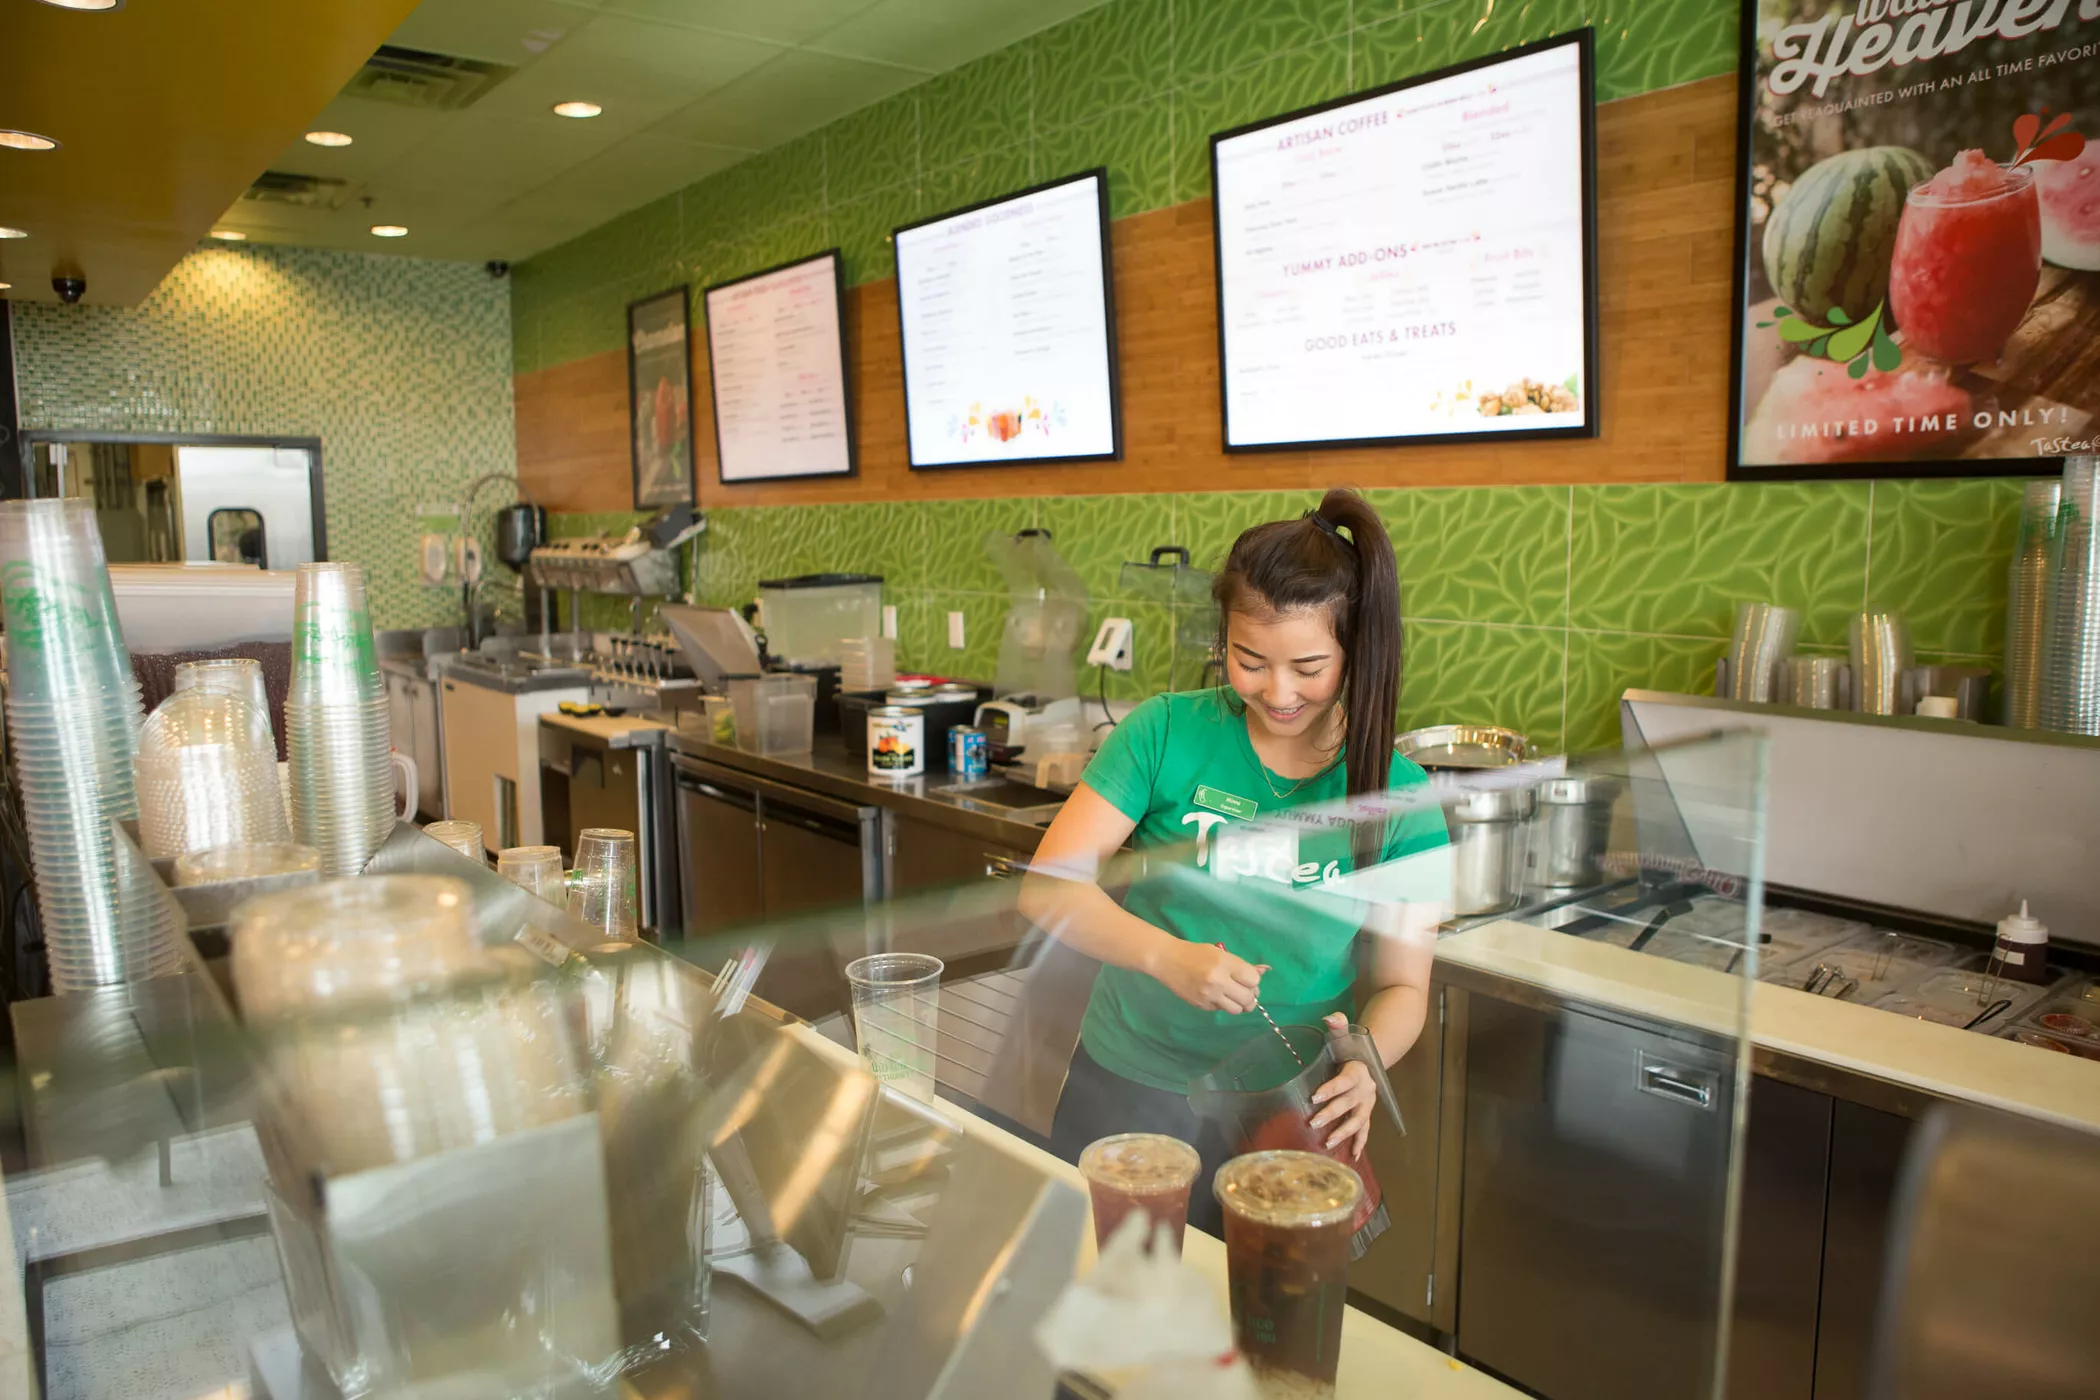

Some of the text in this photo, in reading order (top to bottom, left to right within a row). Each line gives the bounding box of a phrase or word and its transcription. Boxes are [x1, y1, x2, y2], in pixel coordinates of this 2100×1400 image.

[1774, 111, 1795, 128] GET
[1898, 81, 1936, 99] WITH
[1939, 75, 1963, 91] AN
[1967, 68, 1991, 84] ALL
[1995, 58, 2032, 78] TIME
[2038, 42, 2100, 68] FAVORI
[1277, 110, 1388, 152] ARTISAN COFFEE
[1283, 257, 1333, 278] YUMMY
[1338, 244, 1408, 267] ADD-ONS
[1304, 320, 1457, 353] GOOD EATS & TREATS
[1776, 407, 2068, 440] LIMITED TIME ONLY!
